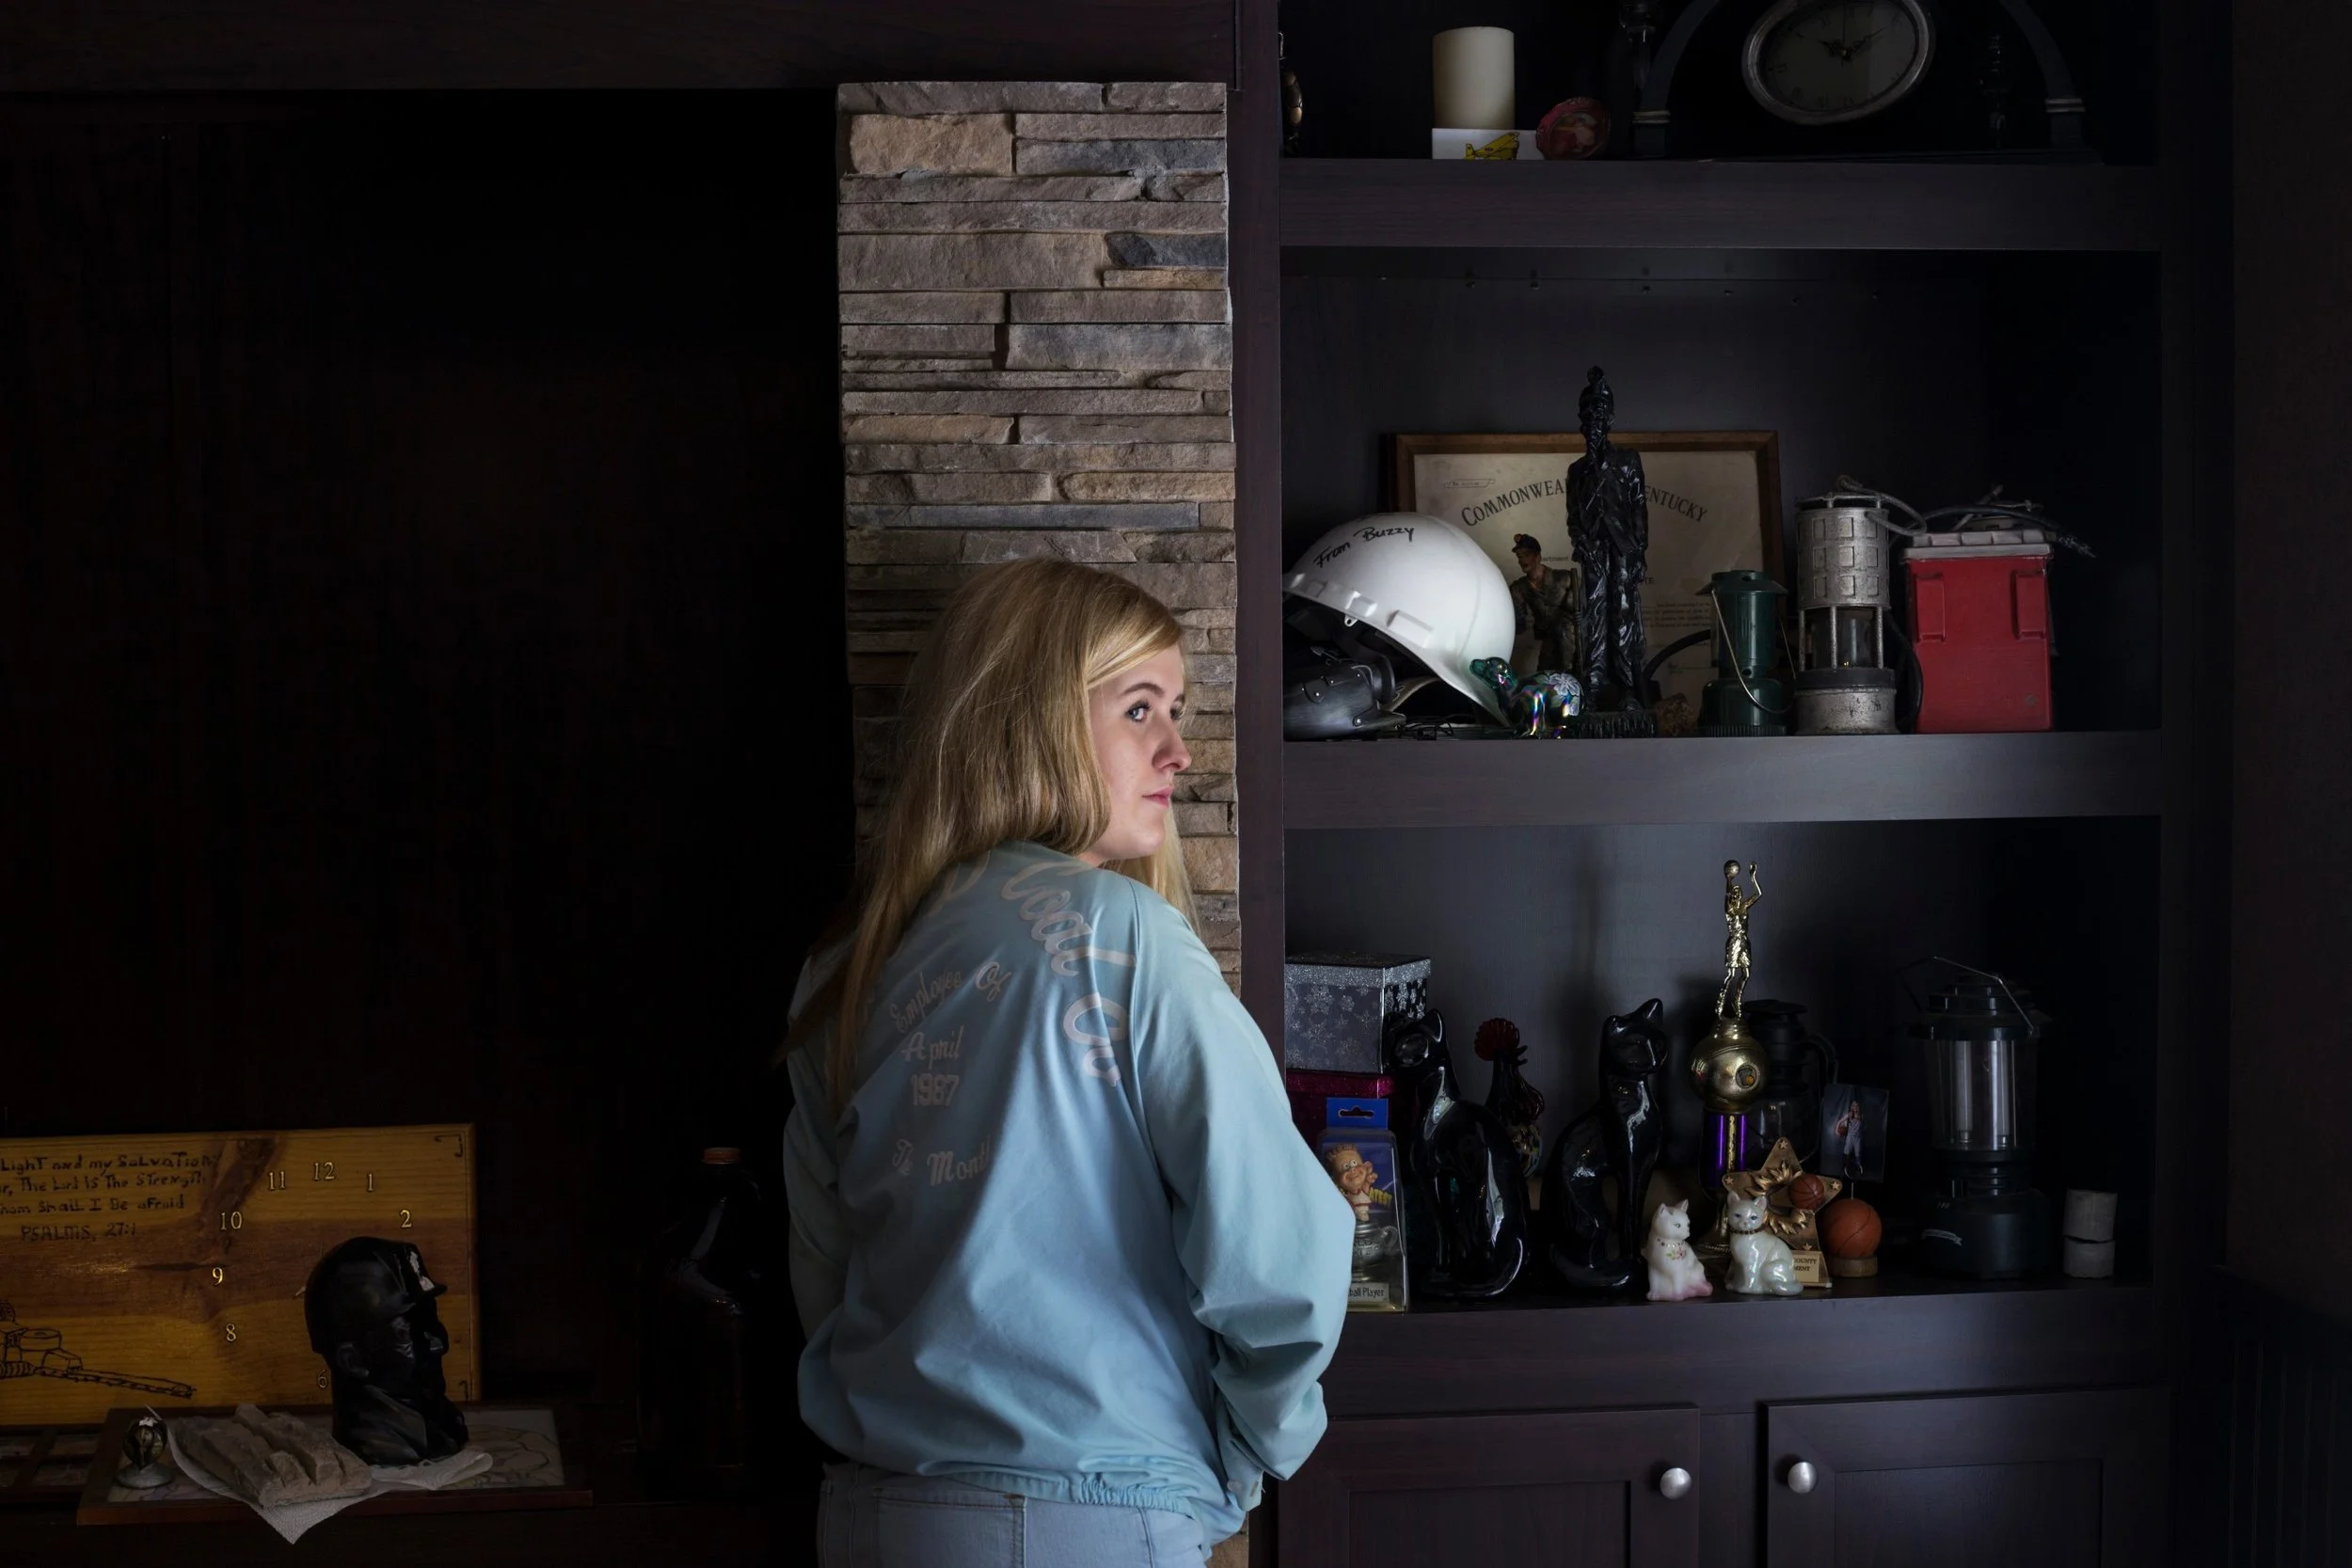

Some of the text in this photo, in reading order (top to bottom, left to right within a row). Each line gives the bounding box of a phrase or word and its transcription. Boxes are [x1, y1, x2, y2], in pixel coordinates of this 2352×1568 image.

[1644, 484, 1708, 522] ENTUCKY
[1353, 526, 1415, 543] Buzzy
[901, 1025, 964, 1070] April
[909, 1073, 960, 1108] 1987
[313, 1162, 336, 1181] 12
[267, 1171, 286, 1192] 11
[367, 1173, 374, 1192] 1
[220, 1211, 243, 1230] 10
[399, 1210, 412, 1228] 2
[212, 1267, 224, 1286] 9
[1348, 1287, 1361, 1297] ball
[225, 1323, 237, 1342] 8
[317, 1369, 329, 1388] 6
